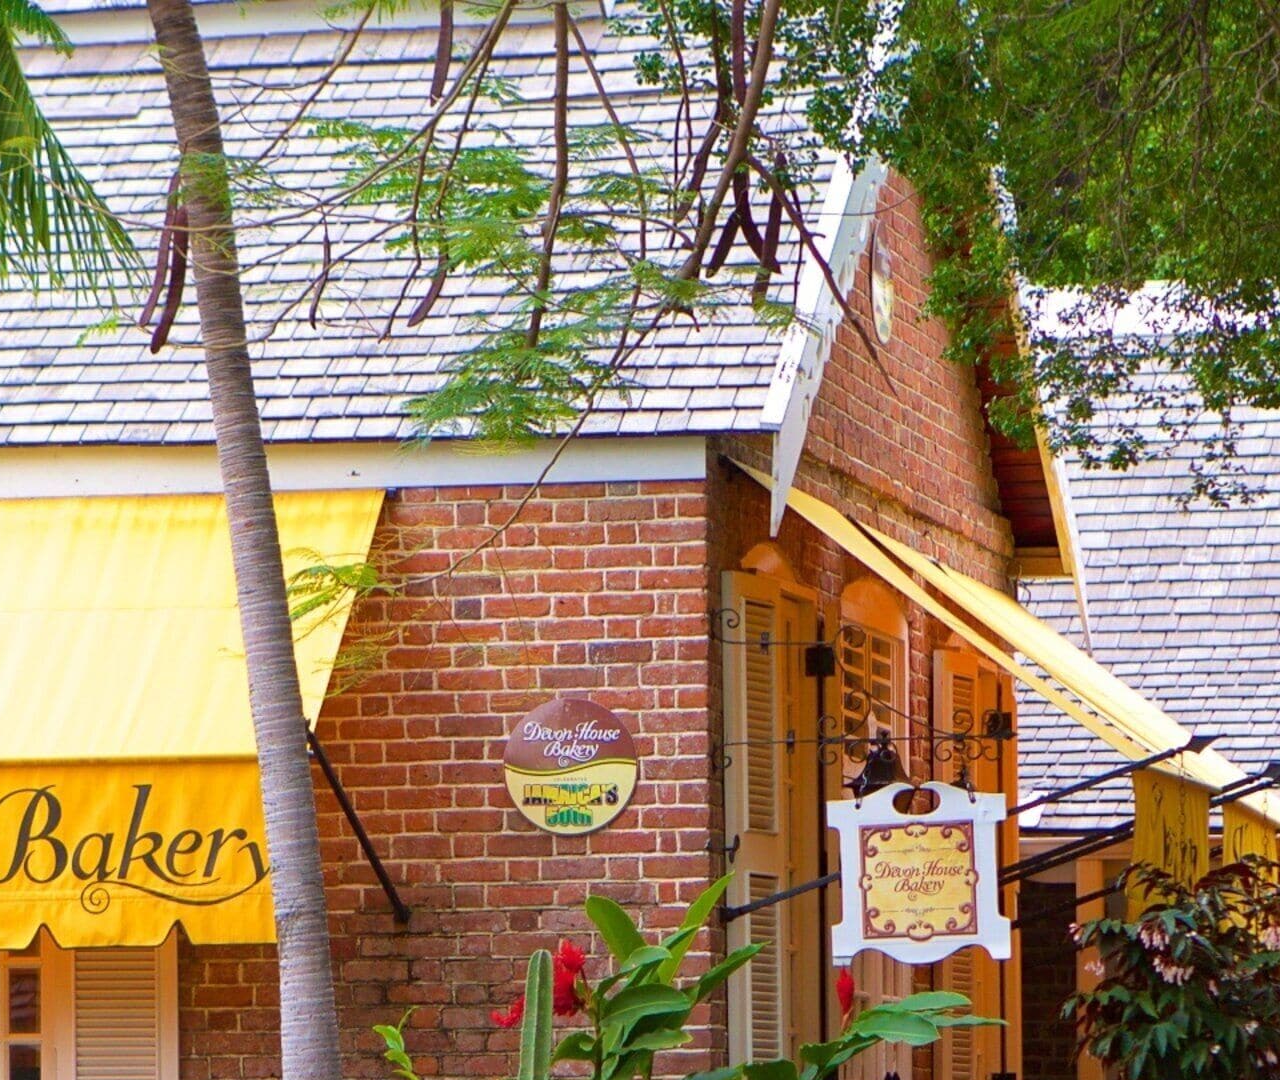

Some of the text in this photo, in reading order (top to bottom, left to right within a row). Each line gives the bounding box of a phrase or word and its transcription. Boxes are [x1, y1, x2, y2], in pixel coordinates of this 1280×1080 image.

[523, 720, 620, 742] Devon House
[543, 740, 599, 767] Bakery
[874, 858, 964, 879] Devon House
[894, 876, 945, 901] Bakery
